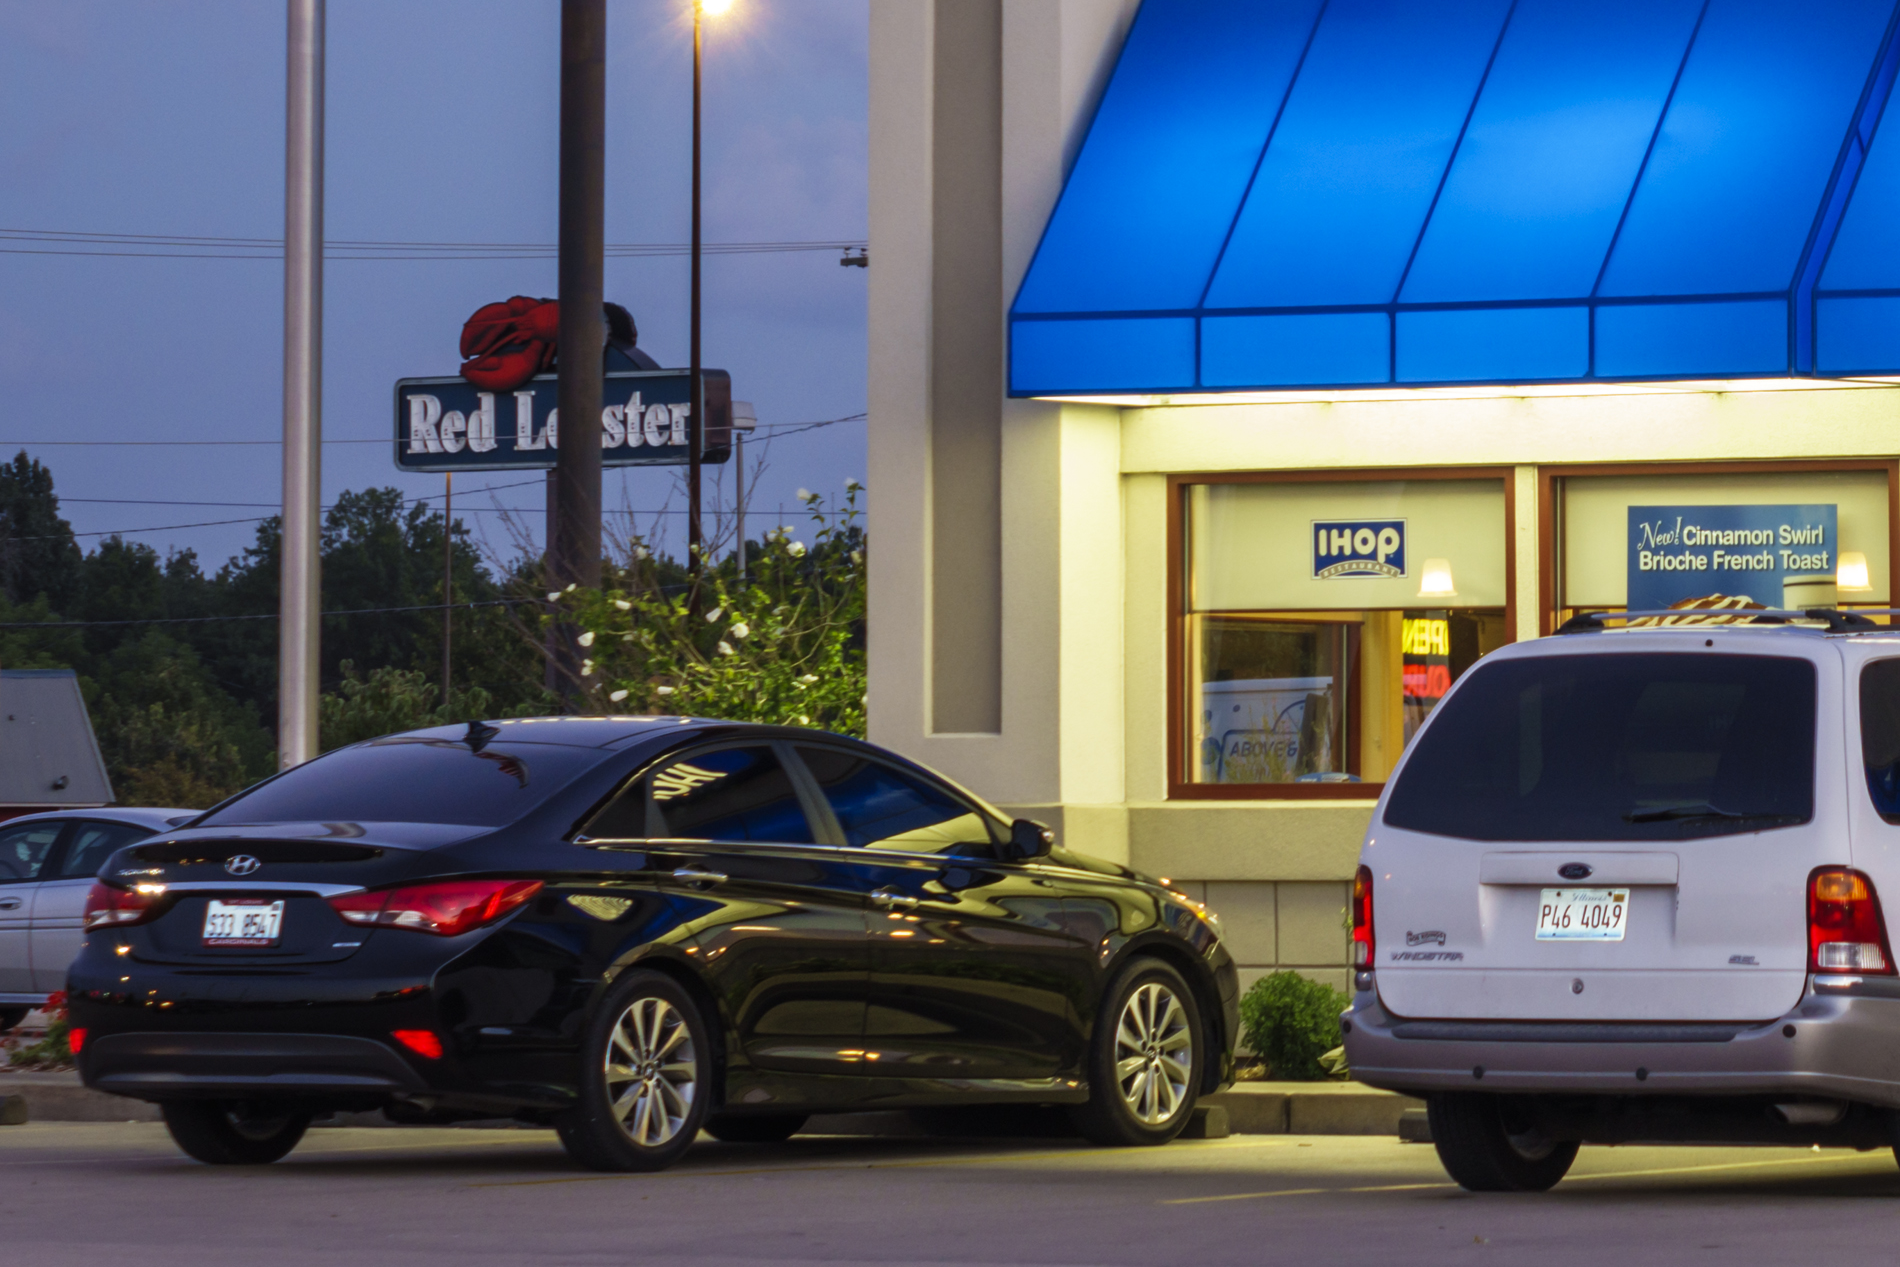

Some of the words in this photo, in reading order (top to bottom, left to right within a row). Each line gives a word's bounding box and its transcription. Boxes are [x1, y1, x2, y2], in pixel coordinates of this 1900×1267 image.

[406, 392, 498, 454] Red
[1318, 527, 1400, 564] IHOP
[1637, 516, 1682, 550] New!
[1683, 525, 1774, 545] Cinnamon
[1779, 524, 1823, 545] Swirl
[1323, 562, 1396, 577] RESTAURANT
[1639, 550, 1708, 570] Brioche
[1713, 550, 1775, 570] French
[1779, 549, 1829, 570] Toast
[1540, 904, 1572, 929] P46
[1581, 904, 1622, 929] 4049
